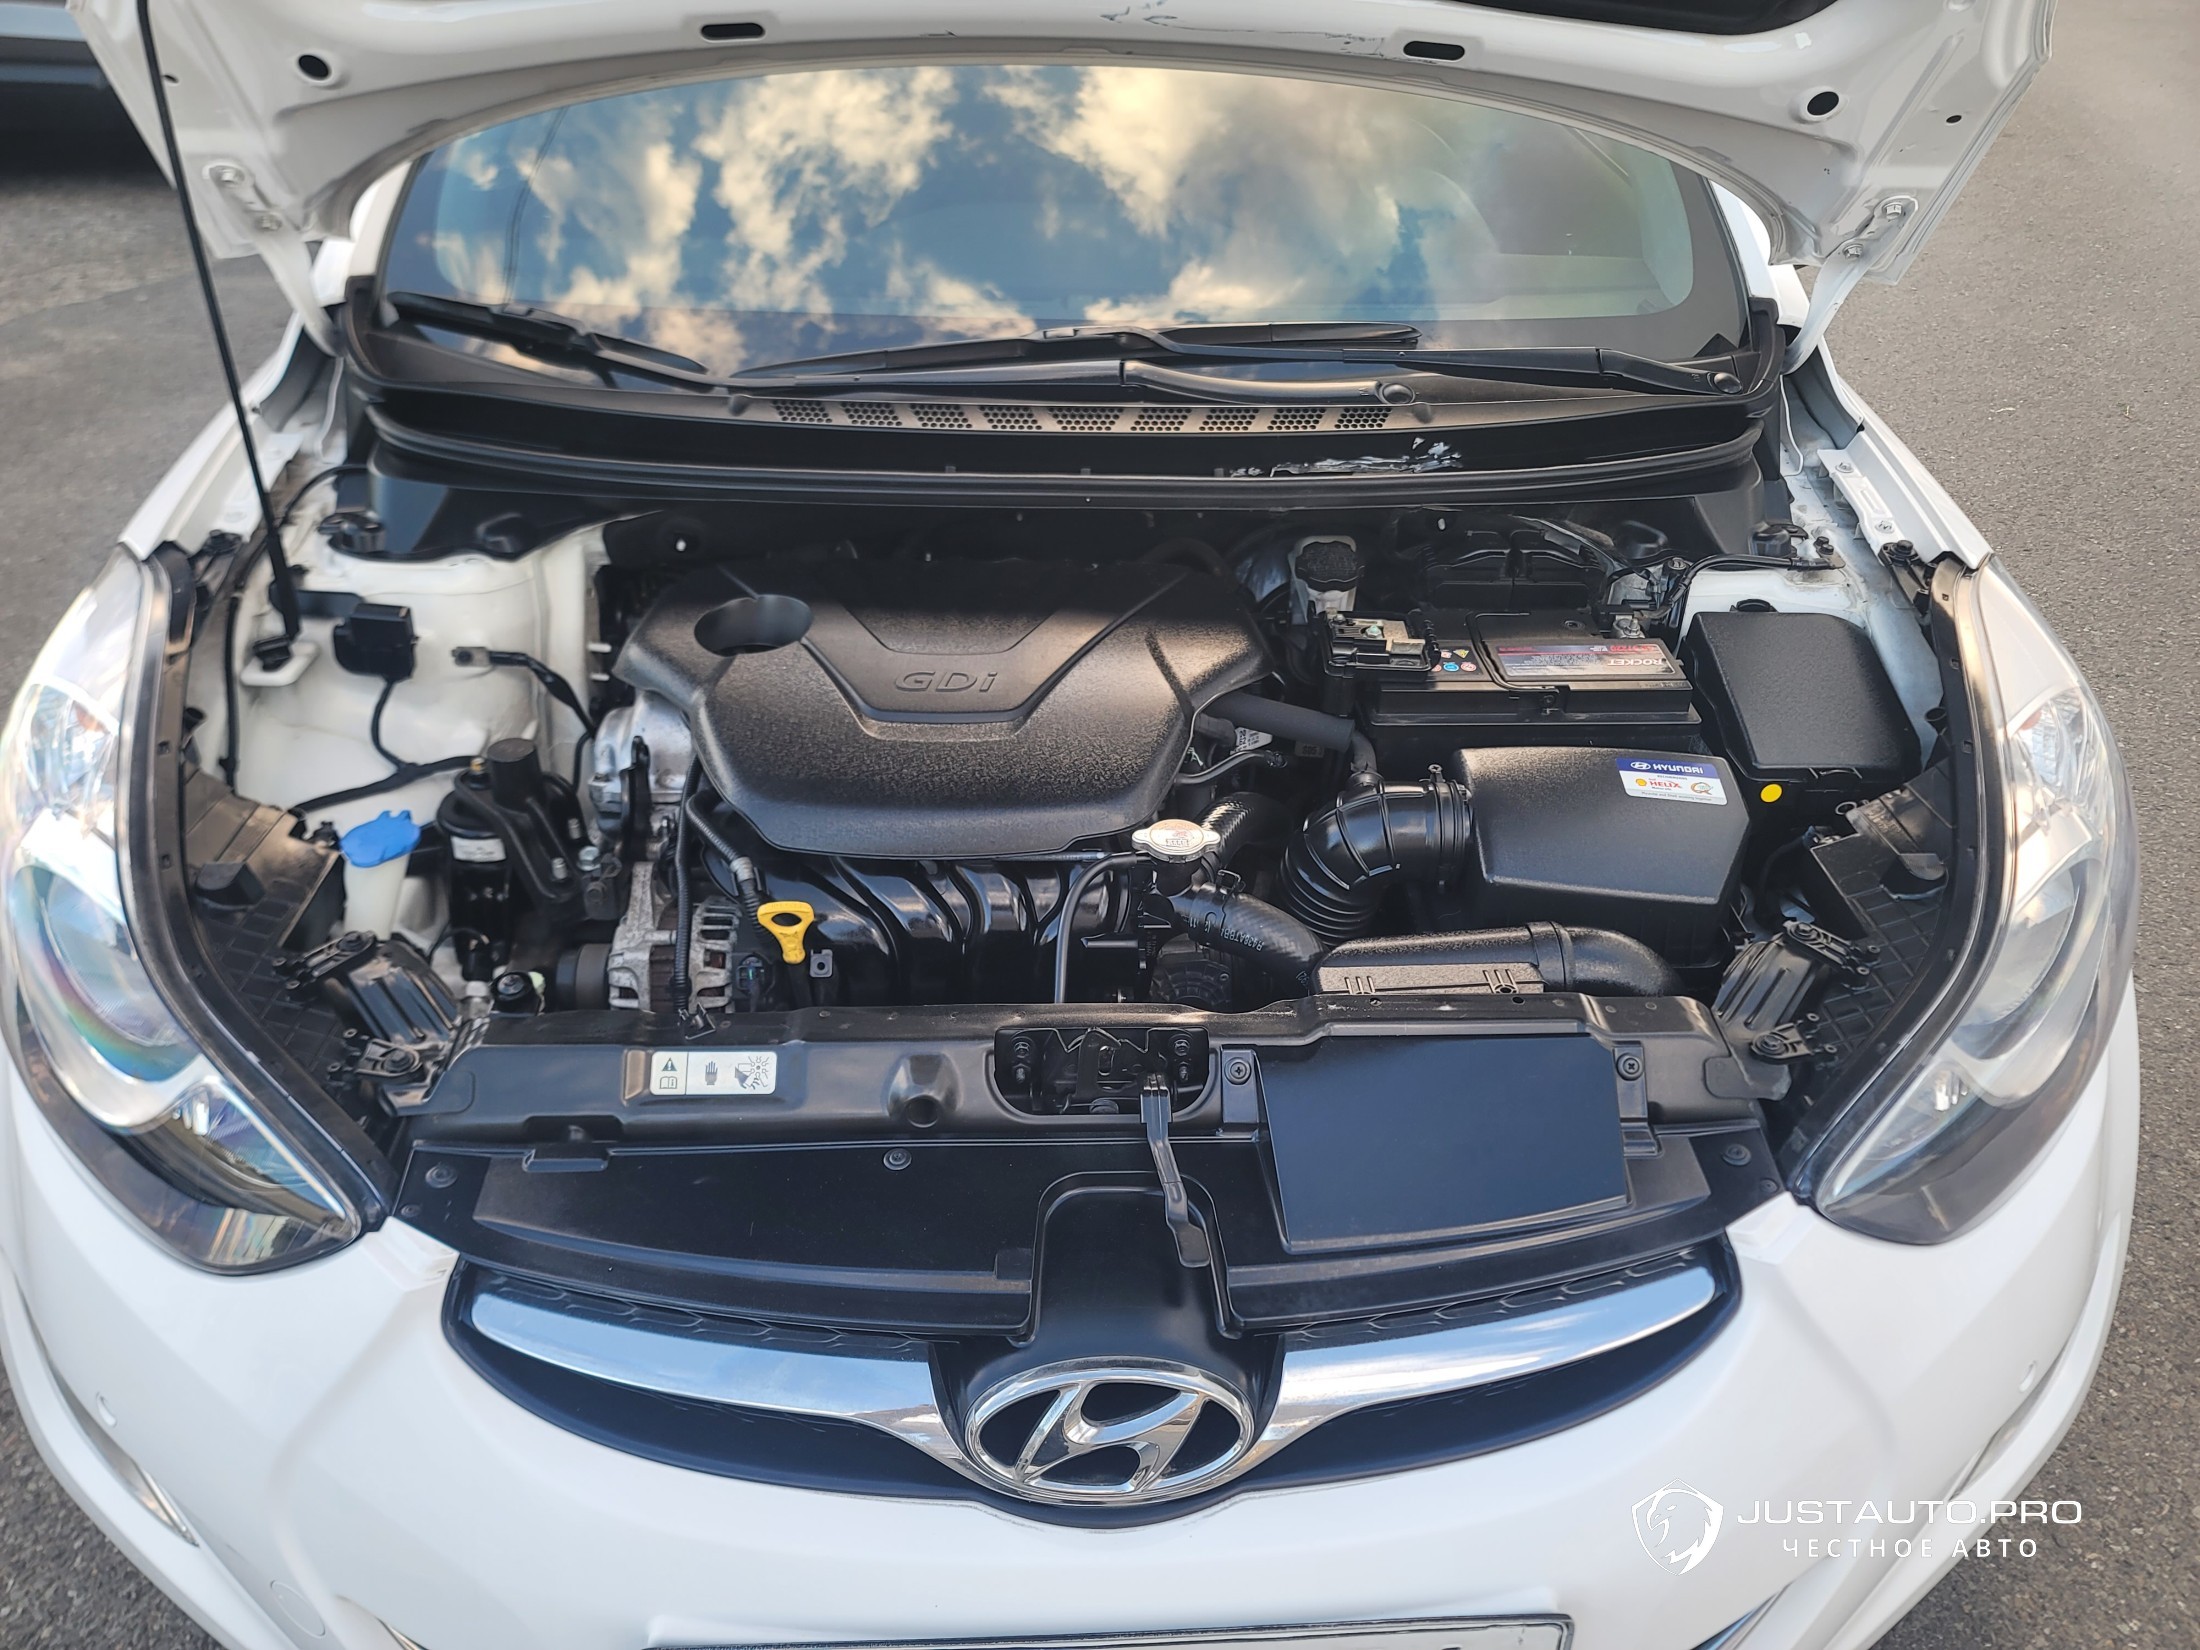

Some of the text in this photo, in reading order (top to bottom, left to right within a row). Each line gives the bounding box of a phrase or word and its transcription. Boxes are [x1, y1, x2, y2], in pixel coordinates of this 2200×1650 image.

[1608, 658, 1663, 666] ROCKET
[895, 671, 998, 692] GDi
[1652, 763, 1704, 774] HYUNDAI
[1649, 780, 1682, 789] HELIX
